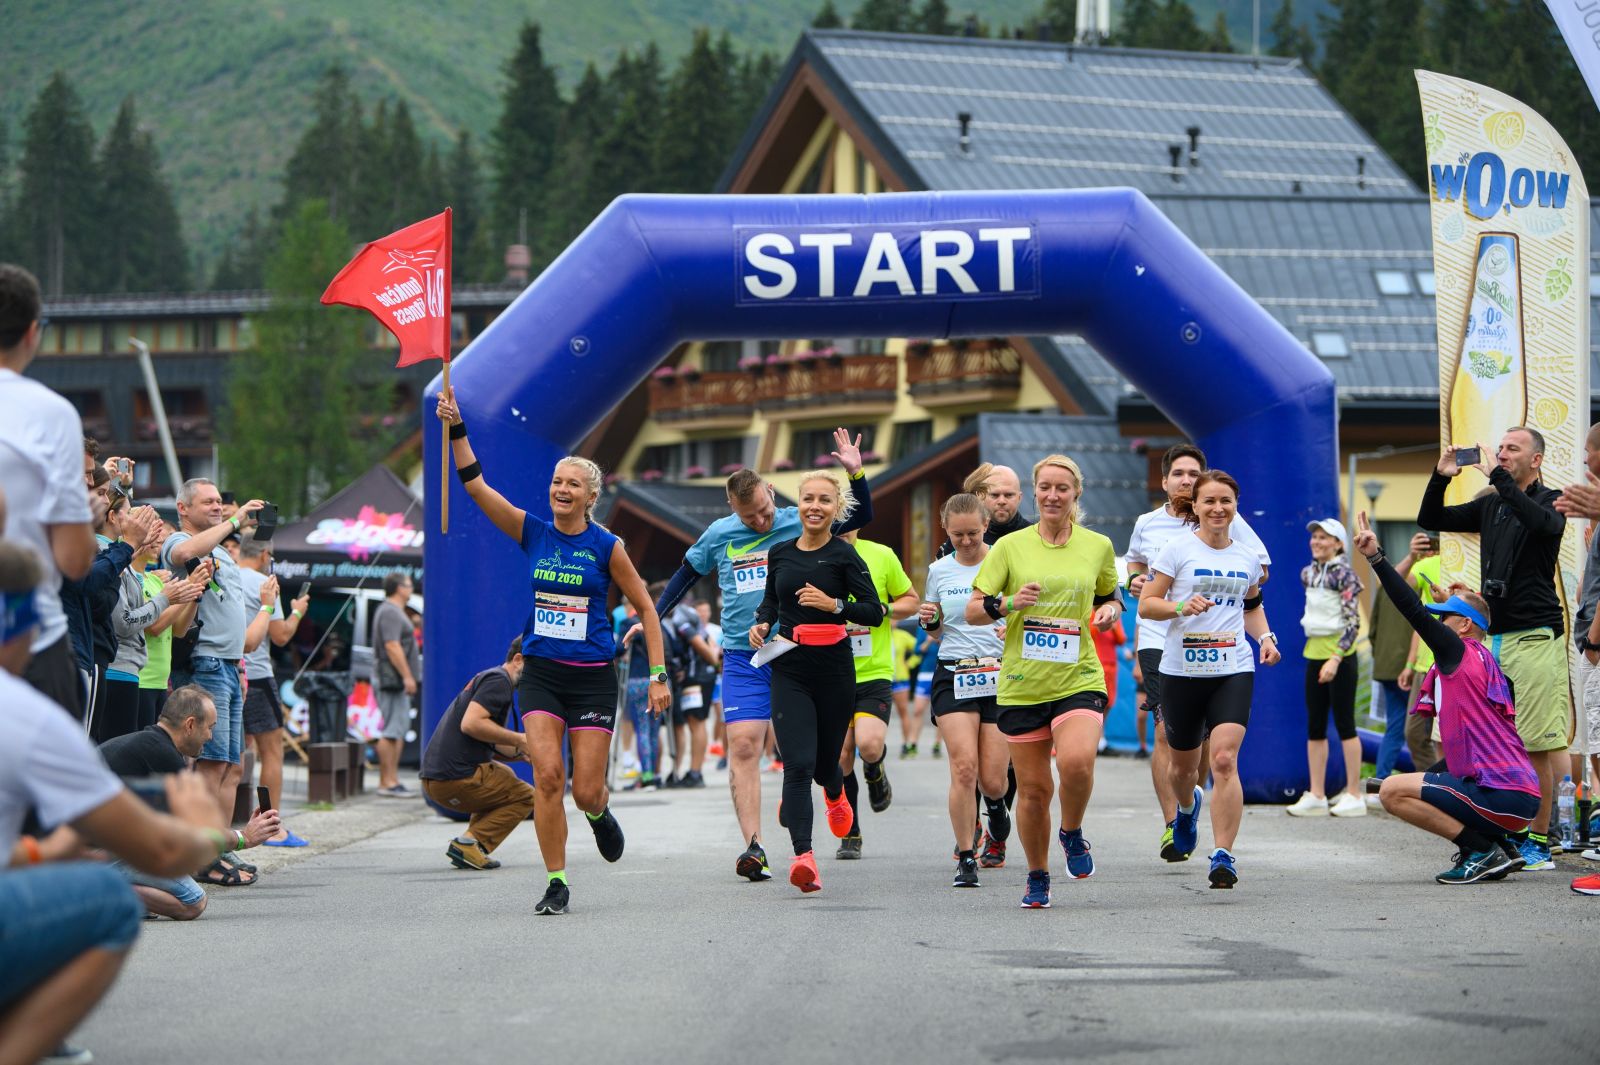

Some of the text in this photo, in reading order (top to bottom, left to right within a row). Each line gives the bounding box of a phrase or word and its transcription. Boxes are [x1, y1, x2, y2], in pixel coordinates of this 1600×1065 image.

[743, 226, 1031, 300] START
[533, 568, 583, 585] OTKD 2020
[737, 566, 766, 582] 015
[536, 609, 576, 627] 002 1
[856, 639, 863, 647] 1
[1025, 631, 1068, 649] 060 1
[1185, 648, 1227, 663] 033 1
[956, 673, 987, 688] 133
[990, 676, 996, 685] 1
